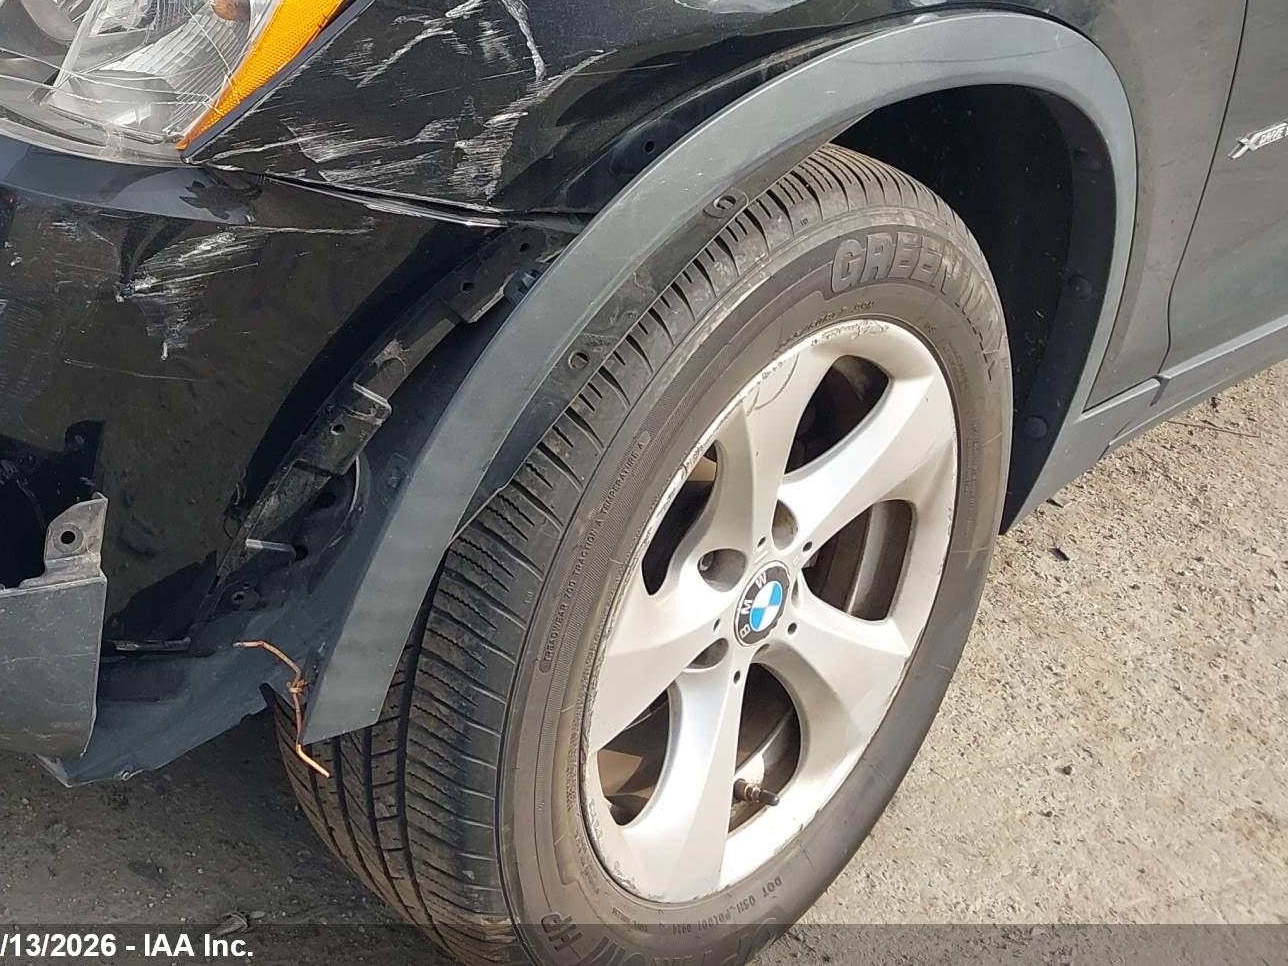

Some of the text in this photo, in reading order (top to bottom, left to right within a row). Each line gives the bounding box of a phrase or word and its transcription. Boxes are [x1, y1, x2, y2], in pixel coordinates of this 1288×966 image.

[543, 603, 569, 662] TREADWEAR
[573, 529, 597, 576] TRACTION
[600, 451, 639, 515] TEMPERATURE
[740, 572, 768, 639] BMW
[761, 875, 782, 898] DOT
[541, 912, 583, 951] HP
